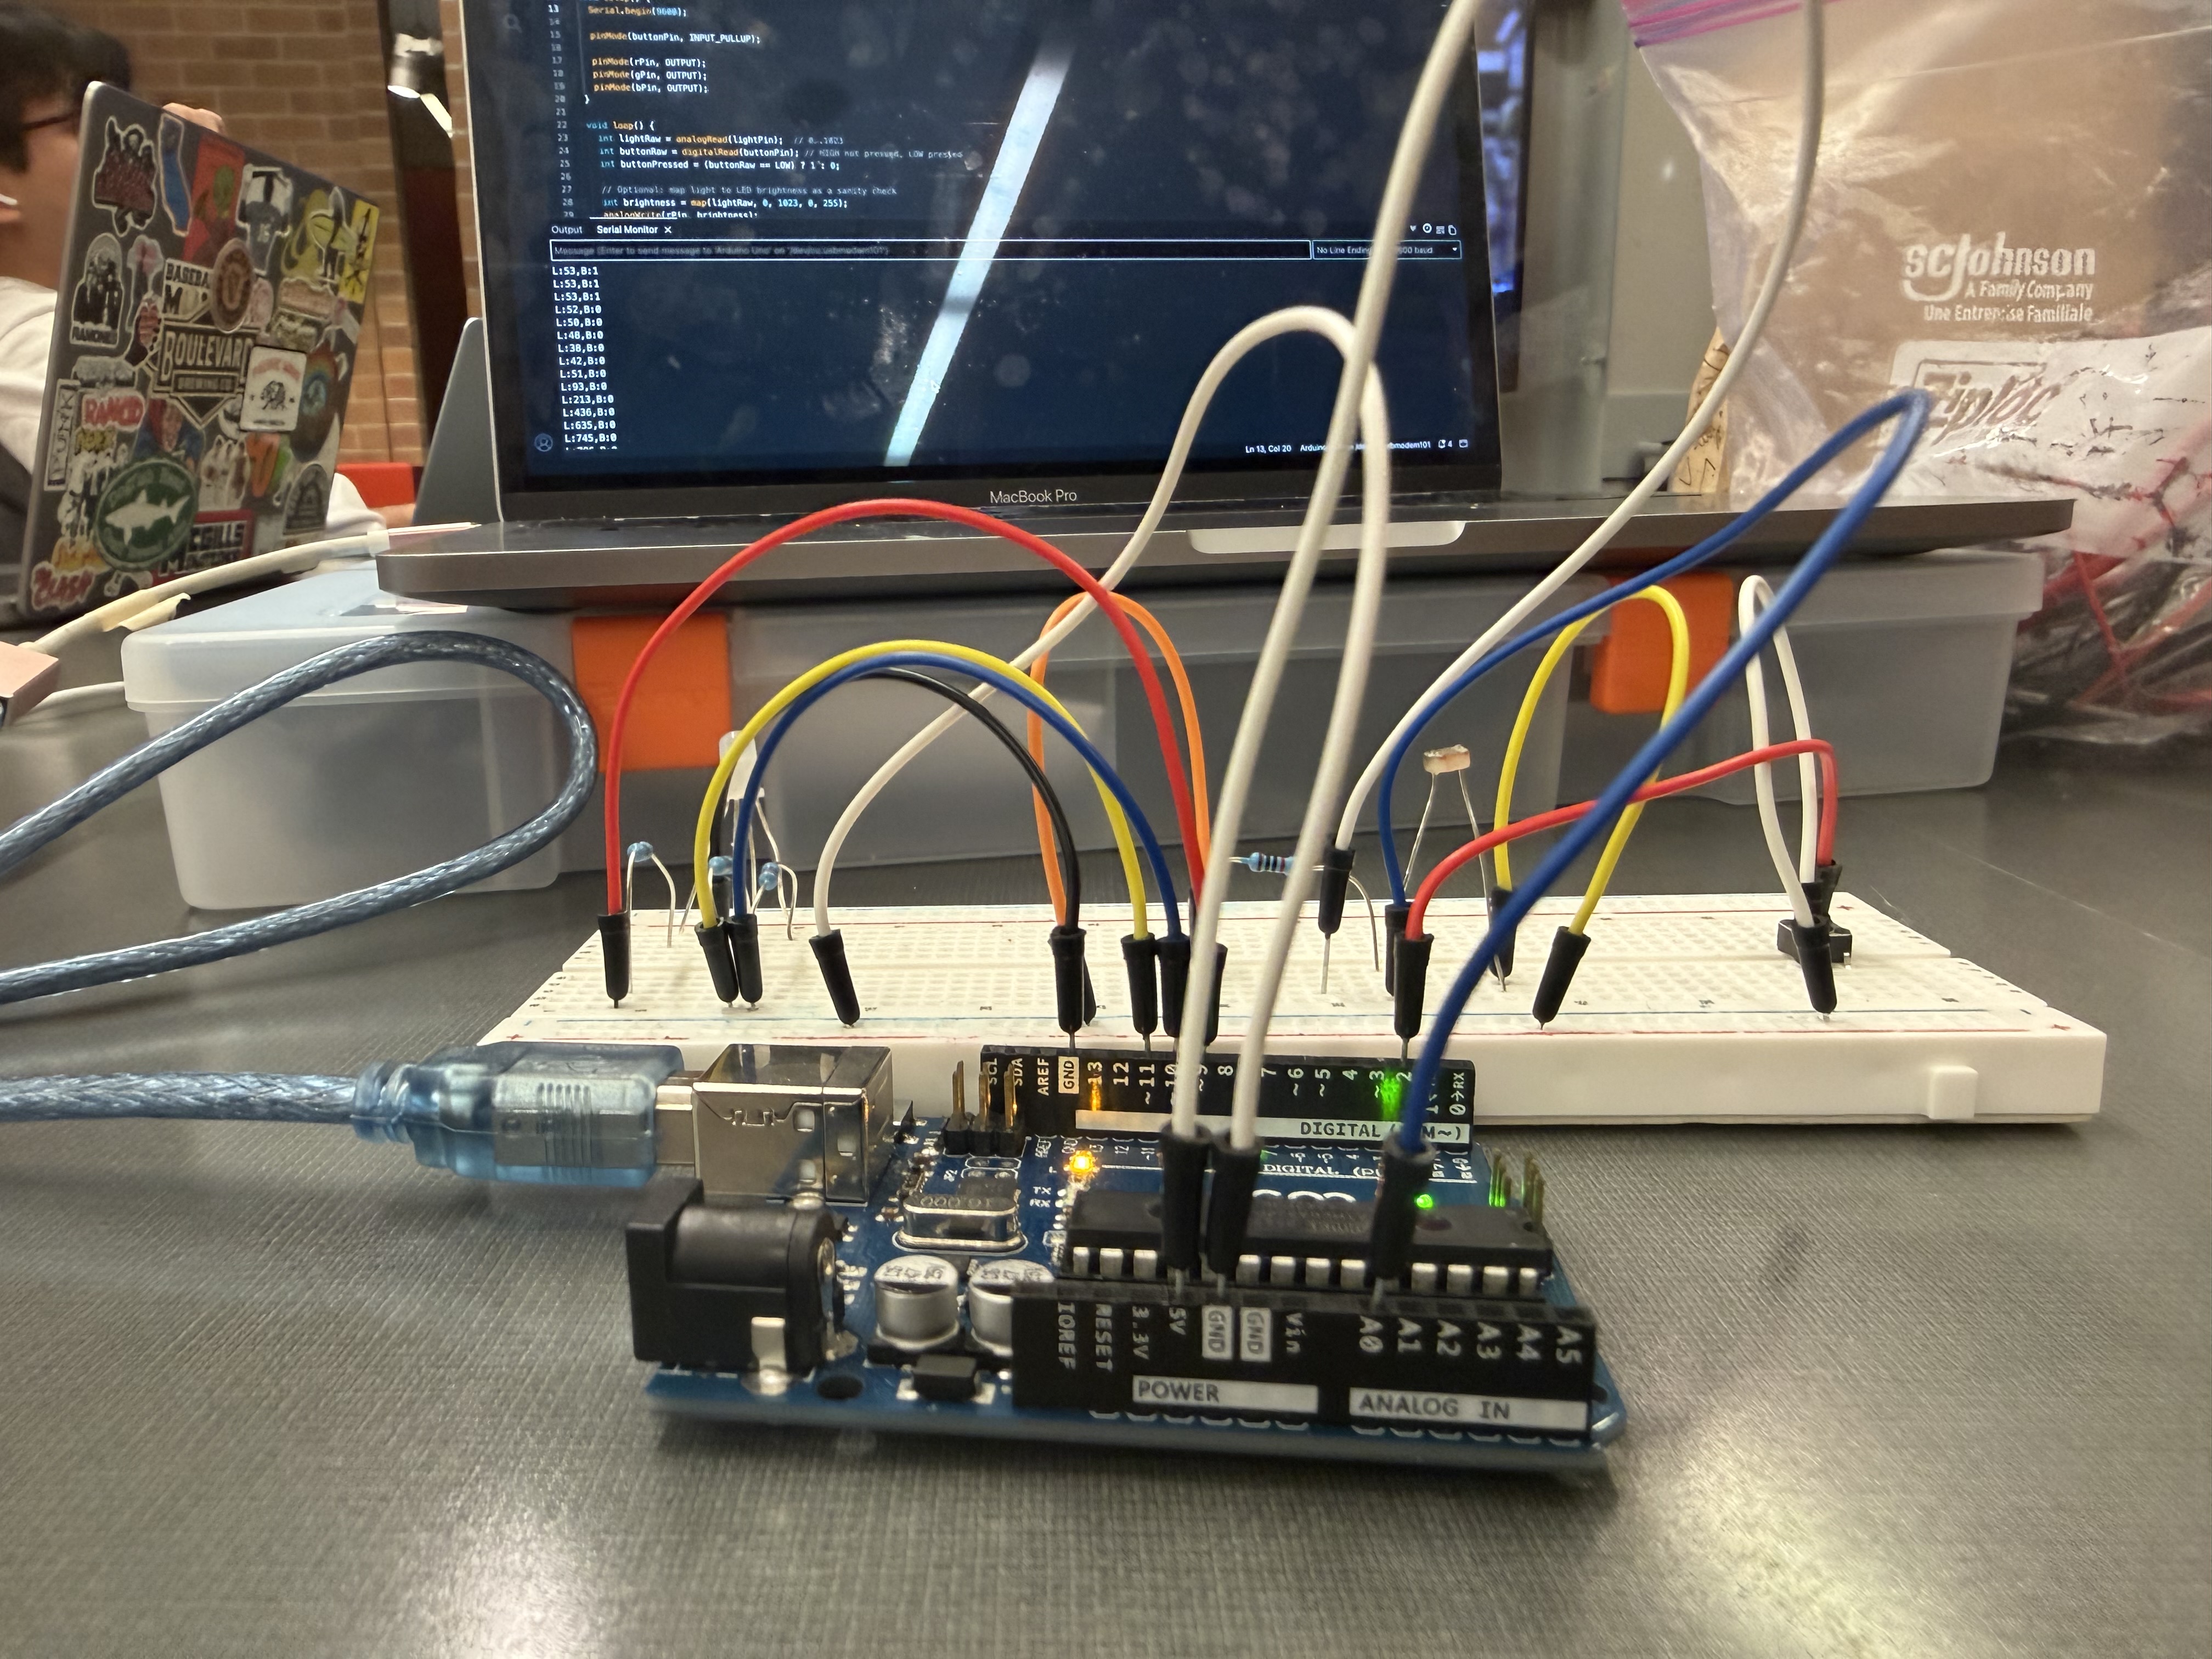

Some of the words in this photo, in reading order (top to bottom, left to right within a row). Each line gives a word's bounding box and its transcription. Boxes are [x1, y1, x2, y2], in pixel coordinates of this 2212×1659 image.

[690, 33, 761, 44] INPUT_PULLUP);
[665, 58, 707, 68] OUTPUT);
[666, 71, 707, 81] OUTPUT);
[667, 83, 708, 93] OUTPUT);
[619, 134, 661, 144] lightRaw
[620, 147, 667, 156] buttonRaw
[620, 160, 689, 168] buttonPressed
[704, 160, 756, 170] (buttonRaw
[775, 161, 795, 171] LOW)
[623, 198, 676, 208] brightness
[691, 199, 757, 208] map(lightRaw,
[778, 199, 803, 208] 1023,
[823, 199, 848, 208] 255);
[551, 225, 583, 235] Output
[597, 225, 622, 234] Serial
[624, 225, 658, 234] Monitor
[1317, 246, 1328, 255] No
[552, 266, 599, 276] L:53,B:1
[553, 279, 600, 289] L:53,B:1
[1964, 281, 1976, 298] A
[1979, 279, 2026, 302] Family
[2027, 280, 2094, 301] Company
[554, 292, 601, 302] L:53,B:1
[555, 305, 602, 315] L:52,B:0
[1923, 304, 1951, 321] Une
[556, 318, 603, 328] L:50,B:0
[557, 331, 604, 341] L:48,B:0
[558, 343, 605, 353] L:38,B:0
[558, 356, 606, 366] L:42,B:0
[560, 369, 607, 379] L:51,B:0
[561, 382, 607, 392] L:93,B:0
[562, 394, 614, 405] L:213,B:0
[562, 407, 616, 417] L:436,B:0
[563, 420, 616, 431] L:635,B:0
[565, 433, 617, 443] L:745,B:0
[1245, 445, 1255, 453] Ln
[1256, 444, 1267, 454] 13,
[1268, 444, 1280, 453] Col
[1281, 444, 1292, 452] 20
[990, 489, 1053, 504] MacBook
[1056, 489, 1077, 503] Pro
[1012, 1058, 1023, 1086] SDA
[1063, 1060, 1075, 1090] GND
[1113, 1062, 1129, 1086] 12
[1217, 1065, 1234, 1076] 8
[1261, 1066, 1277, 1077] 7
[1342, 1069, 1358, 1081] 4
[1037, 1058, 1049, 1096] AREF
[1396, 1071, 1413, 1082] 2
[1314, 1069, 1331, 1097] ~5
[1300, 1122, 1381, 1138] DIGITAL
[1263, 1164, 1339, 1176] DIGITAL
[1033, 1186, 1052, 1195] TX
[1169, 1307, 1187, 1336] 5V
[1058, 1301, 1076, 1370] IOREF
[1132, 1306, 1150, 1360] 3.3V
[1208, 1310, 1226, 1354] GND
[1246, 1312, 1264, 1355] GND
[1285, 1312, 1306, 1354] Vin
[1359, 1315, 1384, 1353] A0
[1397, 1317, 1422, 1353] A1
[1095, 1304, 1113, 1372] RESET
[1436, 1319, 1462, 1357] A2
[1477, 1322, 1502, 1359] A3
[1516, 1323, 1542, 1361] A4
[1555, 1325, 1583, 1364] A5
[1138, 1380, 1220, 1403] POWER
[1359, 1393, 1459, 1418] ANALOG
[1480, 1401, 1510, 1420] IN
